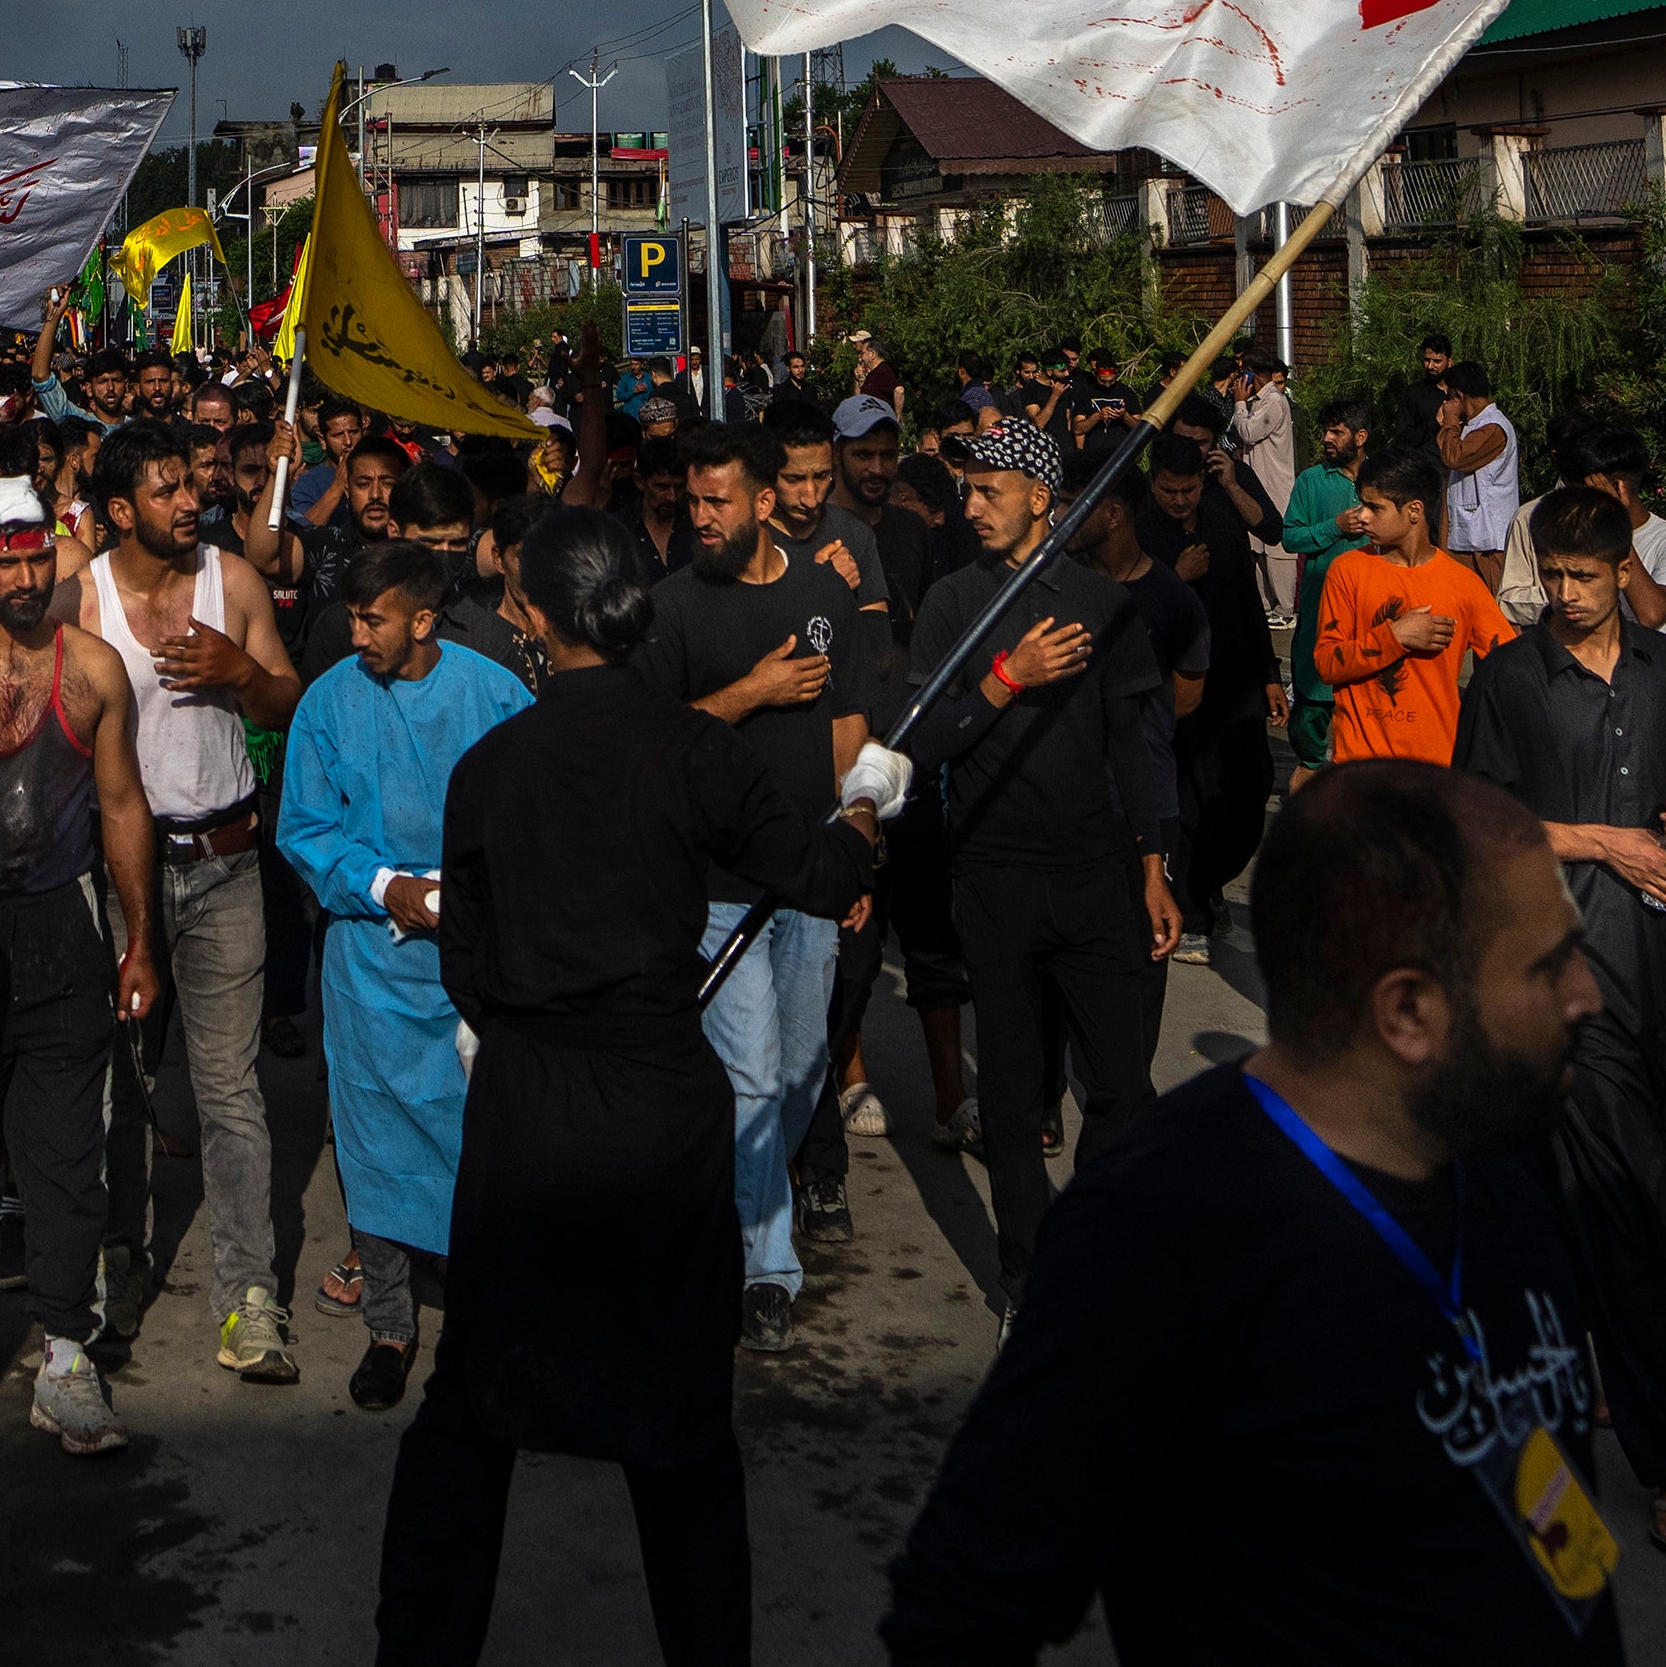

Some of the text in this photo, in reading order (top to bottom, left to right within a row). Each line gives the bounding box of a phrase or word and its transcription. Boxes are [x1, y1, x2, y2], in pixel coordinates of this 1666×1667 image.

[639, 241, 667, 279] P
[273, 589, 298, 600] SALUTE
[1365, 707, 1417, 723] PEACE
